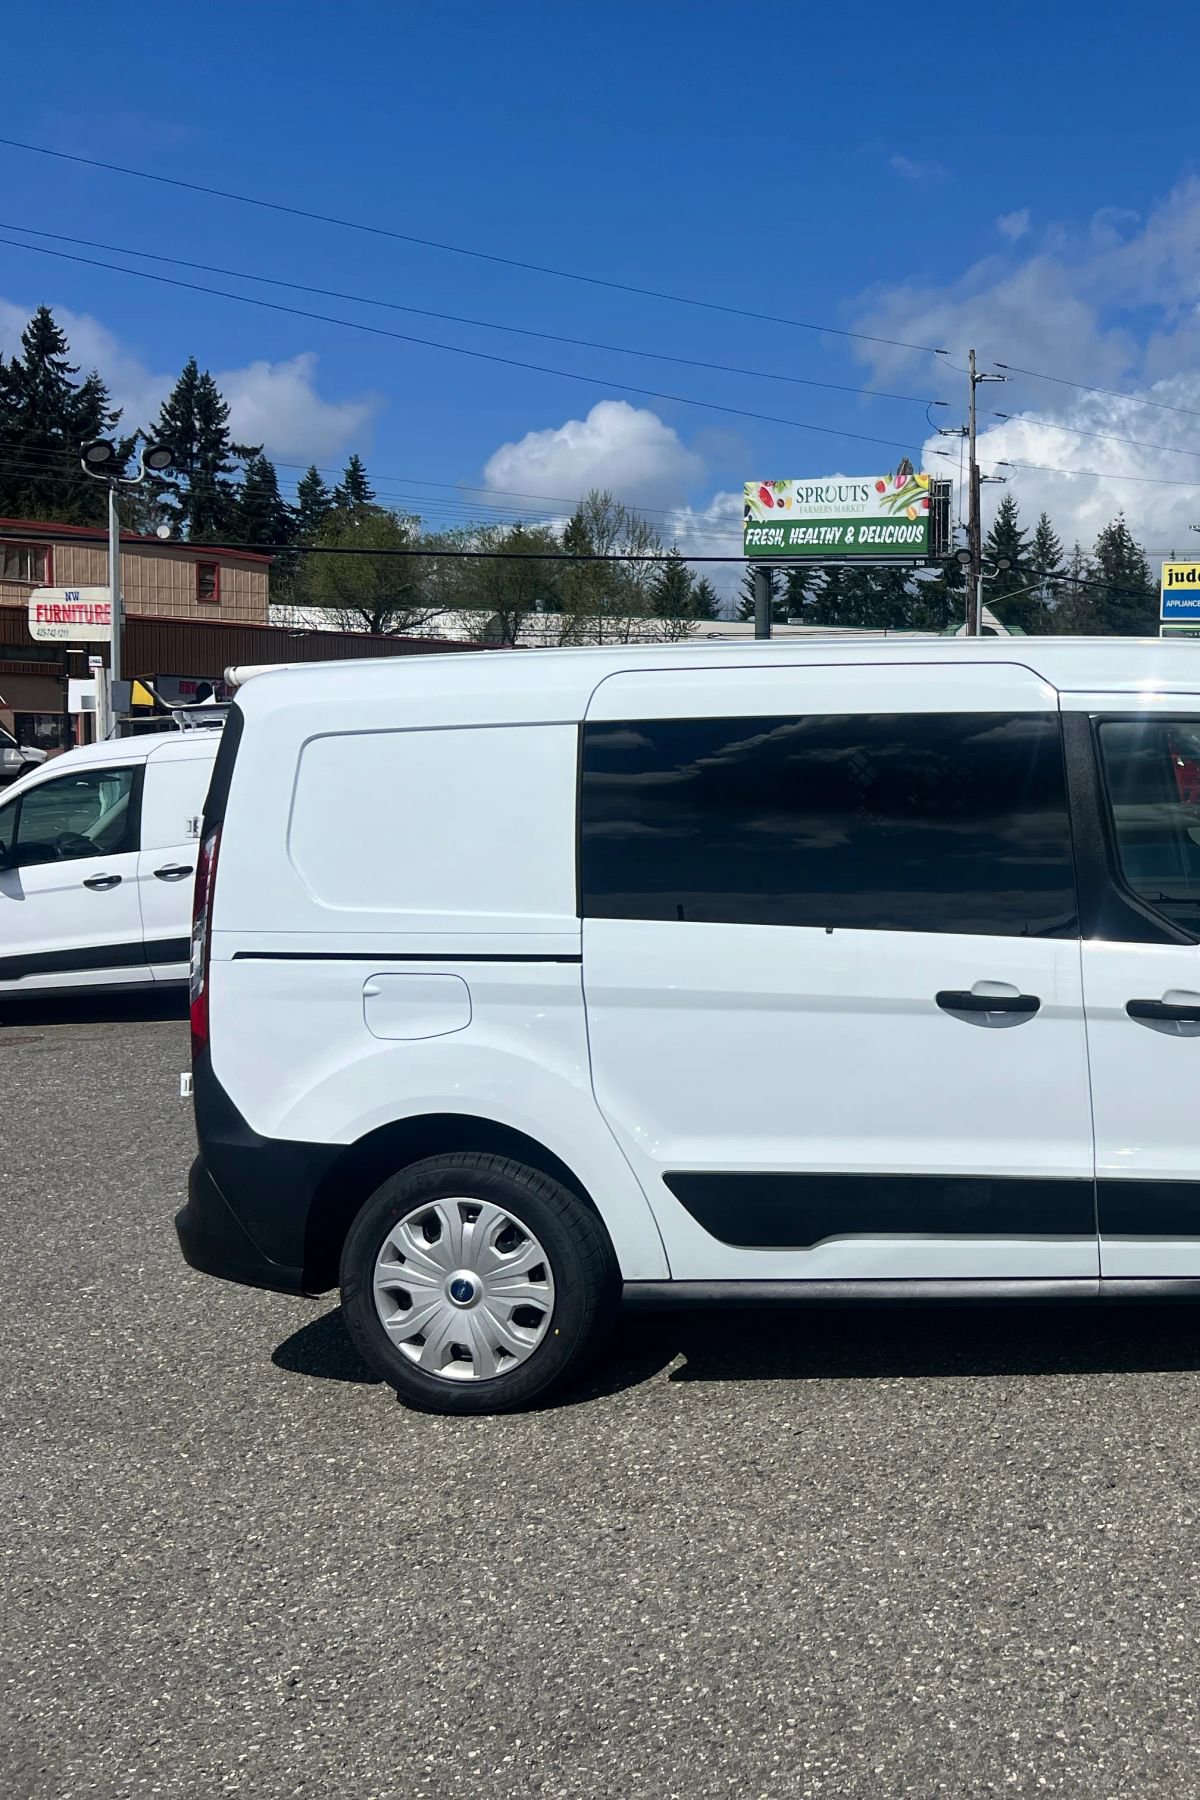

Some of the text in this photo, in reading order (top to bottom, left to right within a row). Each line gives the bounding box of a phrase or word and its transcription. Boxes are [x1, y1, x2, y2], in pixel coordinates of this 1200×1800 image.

[796, 484, 869, 504] SPROUTS
[799, 504, 866, 514] FARMERS MARKET
[745, 525, 924, 547] FRESH, HEALTHY & DELICIOUS
[65, 591, 80, 602] NW
[36, 603, 111, 625] FURNITURE
